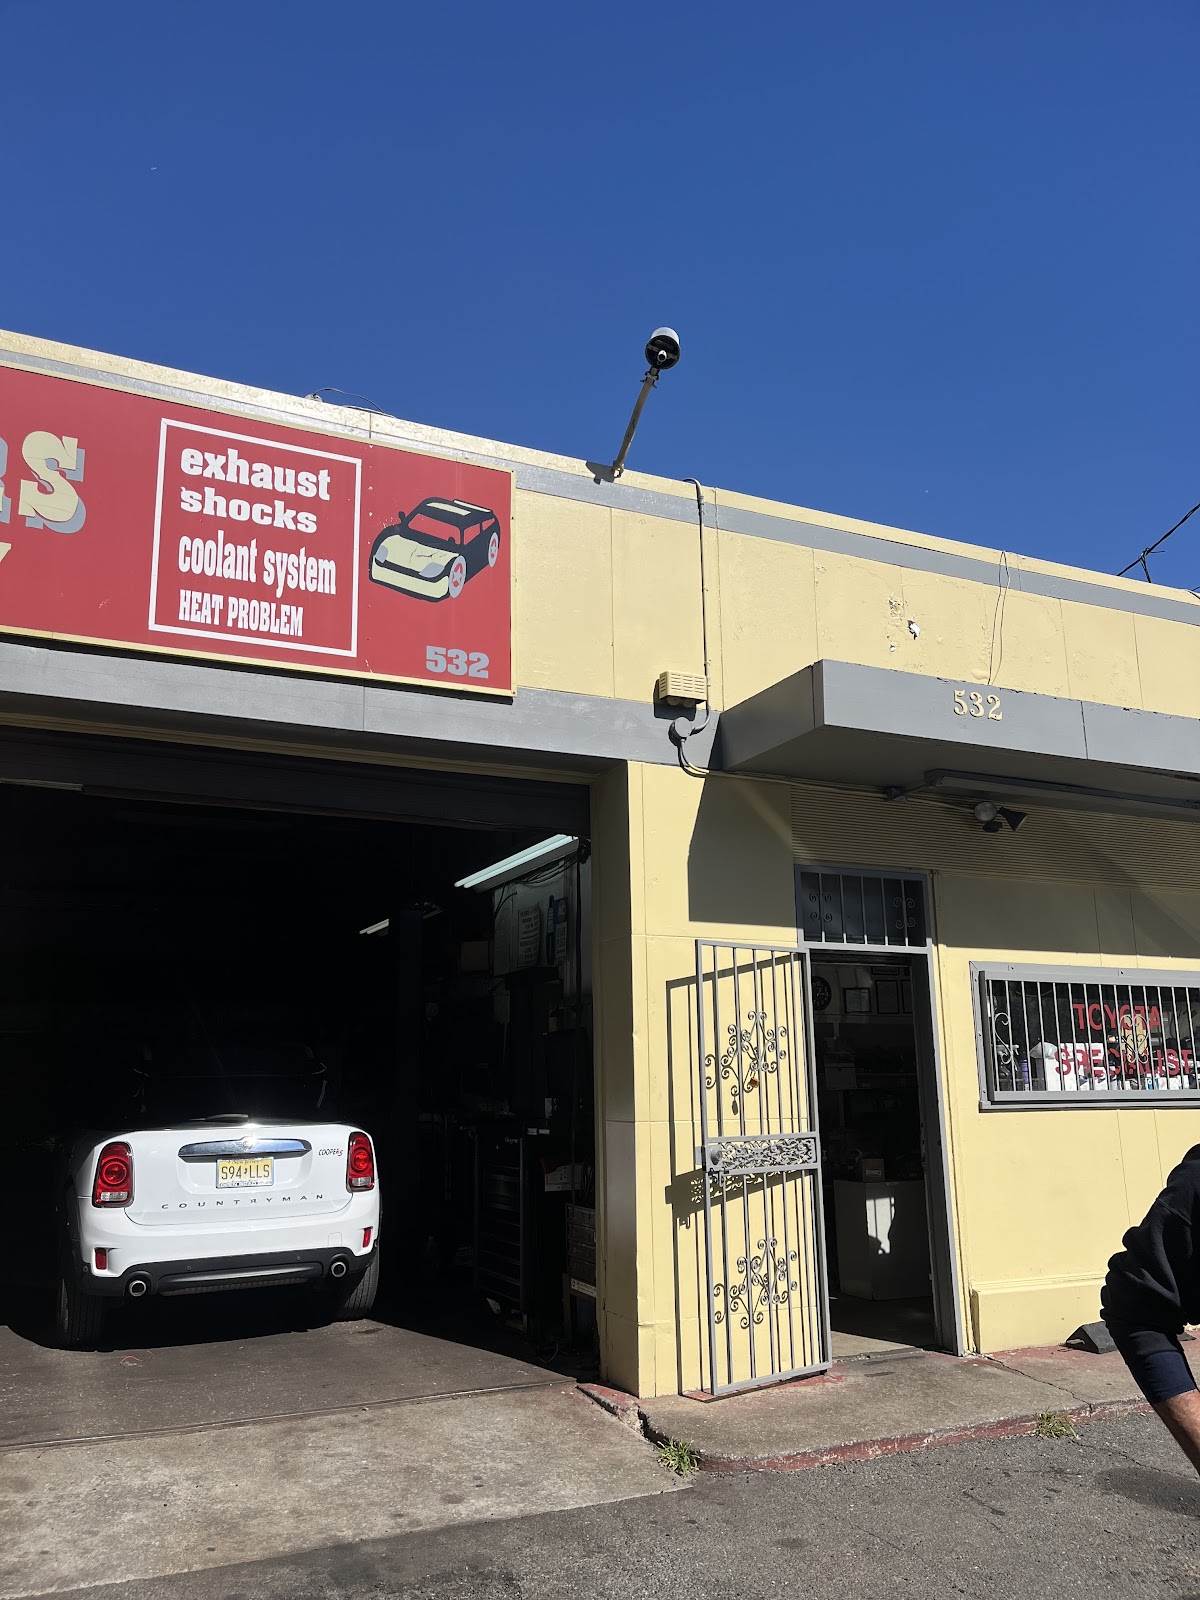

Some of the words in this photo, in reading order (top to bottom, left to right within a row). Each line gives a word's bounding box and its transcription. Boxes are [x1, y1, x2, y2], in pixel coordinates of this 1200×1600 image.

[0, 431, 86, 534] S
[180, 447, 331, 501] exhaust
[180, 486, 318, 534] shocks
[178, 530, 257, 583] coolant
[263, 547, 337, 599] system
[178, 589, 224, 625] HEAT
[227, 596, 304, 637] PROBLEM
[426, 645, 490, 679] 532
[953, 689, 1003, 721] 532
[1072, 1003, 1162, 1031] TOYOTA
[161, 1194, 324, 1210] COUNTRYMAN
